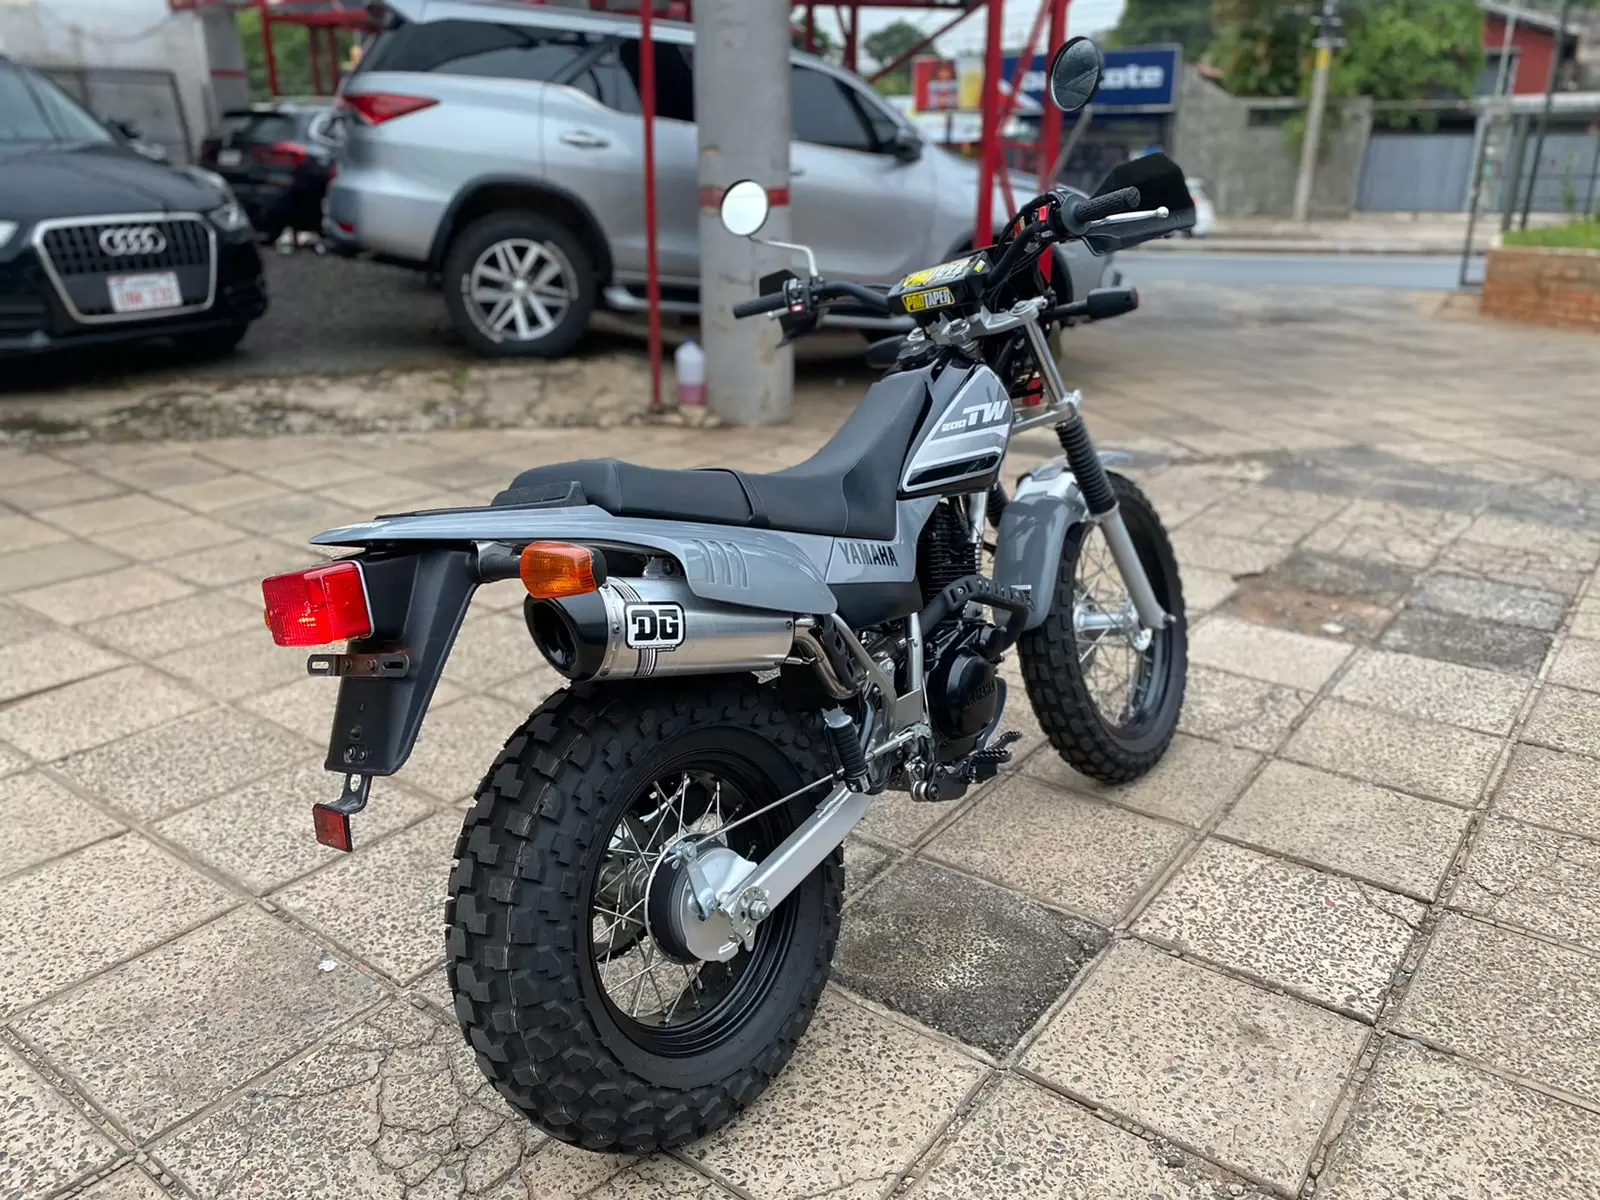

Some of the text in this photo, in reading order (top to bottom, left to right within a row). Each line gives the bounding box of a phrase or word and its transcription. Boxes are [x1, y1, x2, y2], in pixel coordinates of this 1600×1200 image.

[941, 400, 1009, 432] 200 TW
[838, 542, 899, 567] YAMAHA
